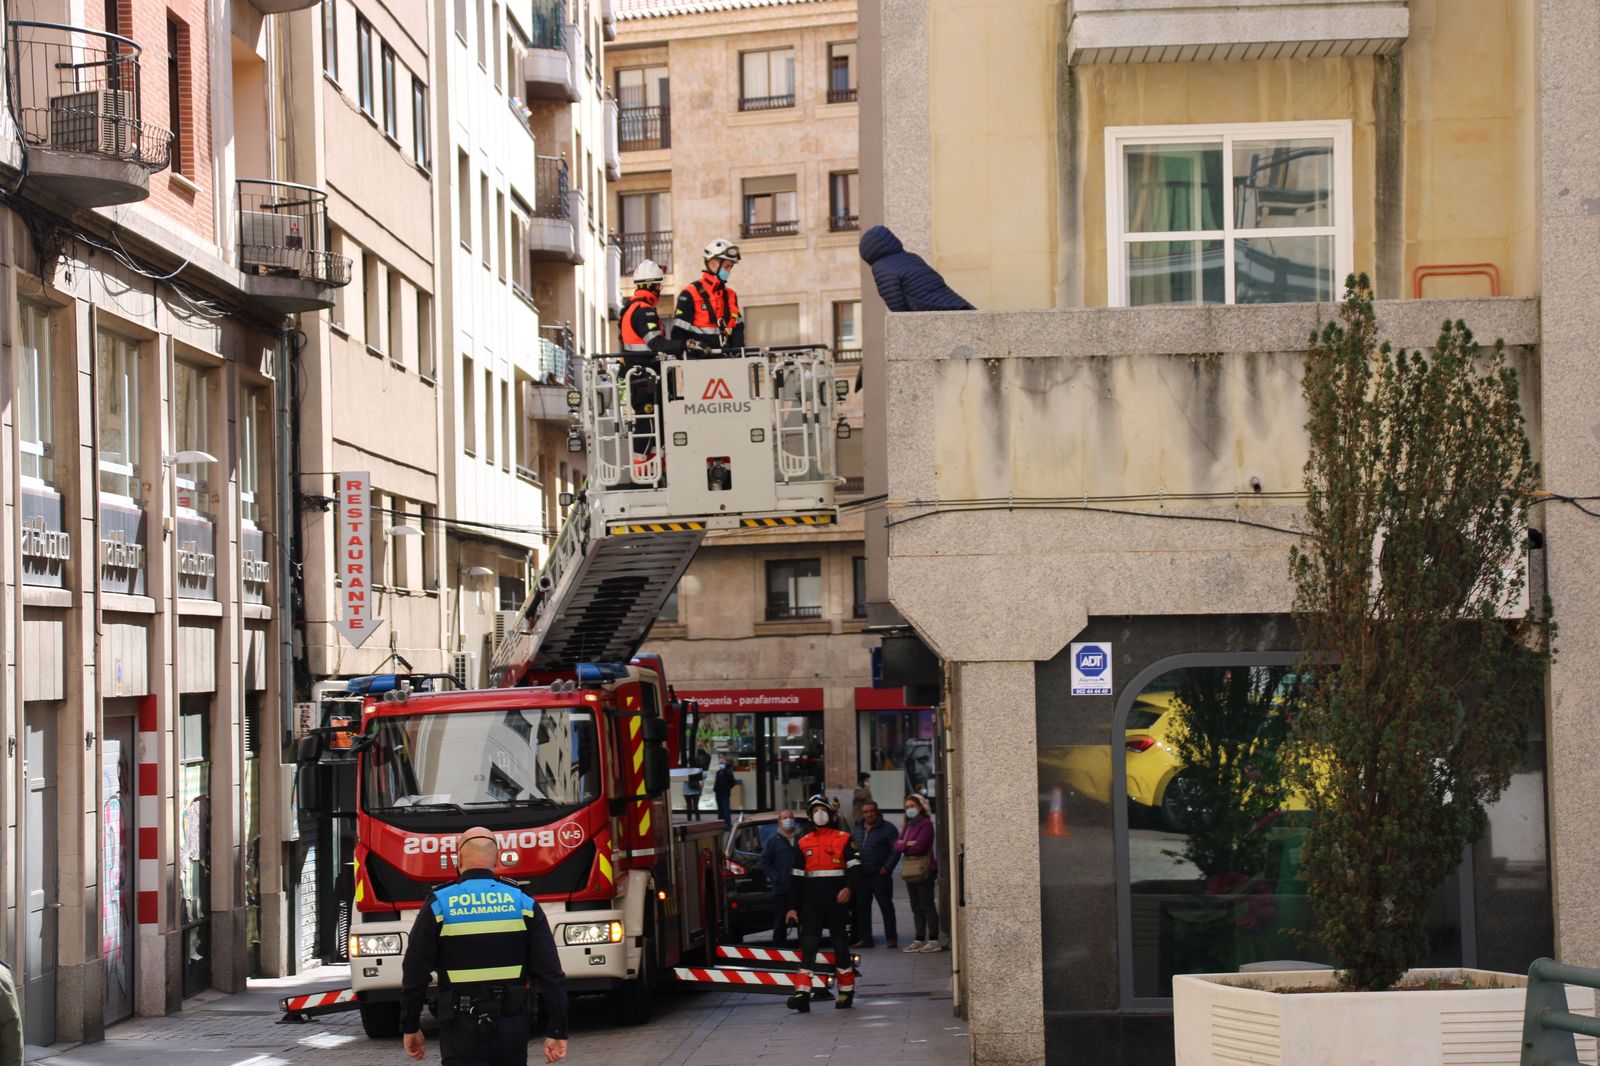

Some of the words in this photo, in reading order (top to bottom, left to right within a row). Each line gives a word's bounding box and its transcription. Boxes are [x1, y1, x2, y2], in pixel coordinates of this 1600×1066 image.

[684, 401, 752, 414] MAGIRUS
[346, 480, 365, 629] RESTAURANTE
[1081, 655, 1102, 666] ADT
[739, 694, 799, 706] parafarmacia
[562, 830, 581, 840] V-5
[449, 904, 516, 916] SALAMANCA
